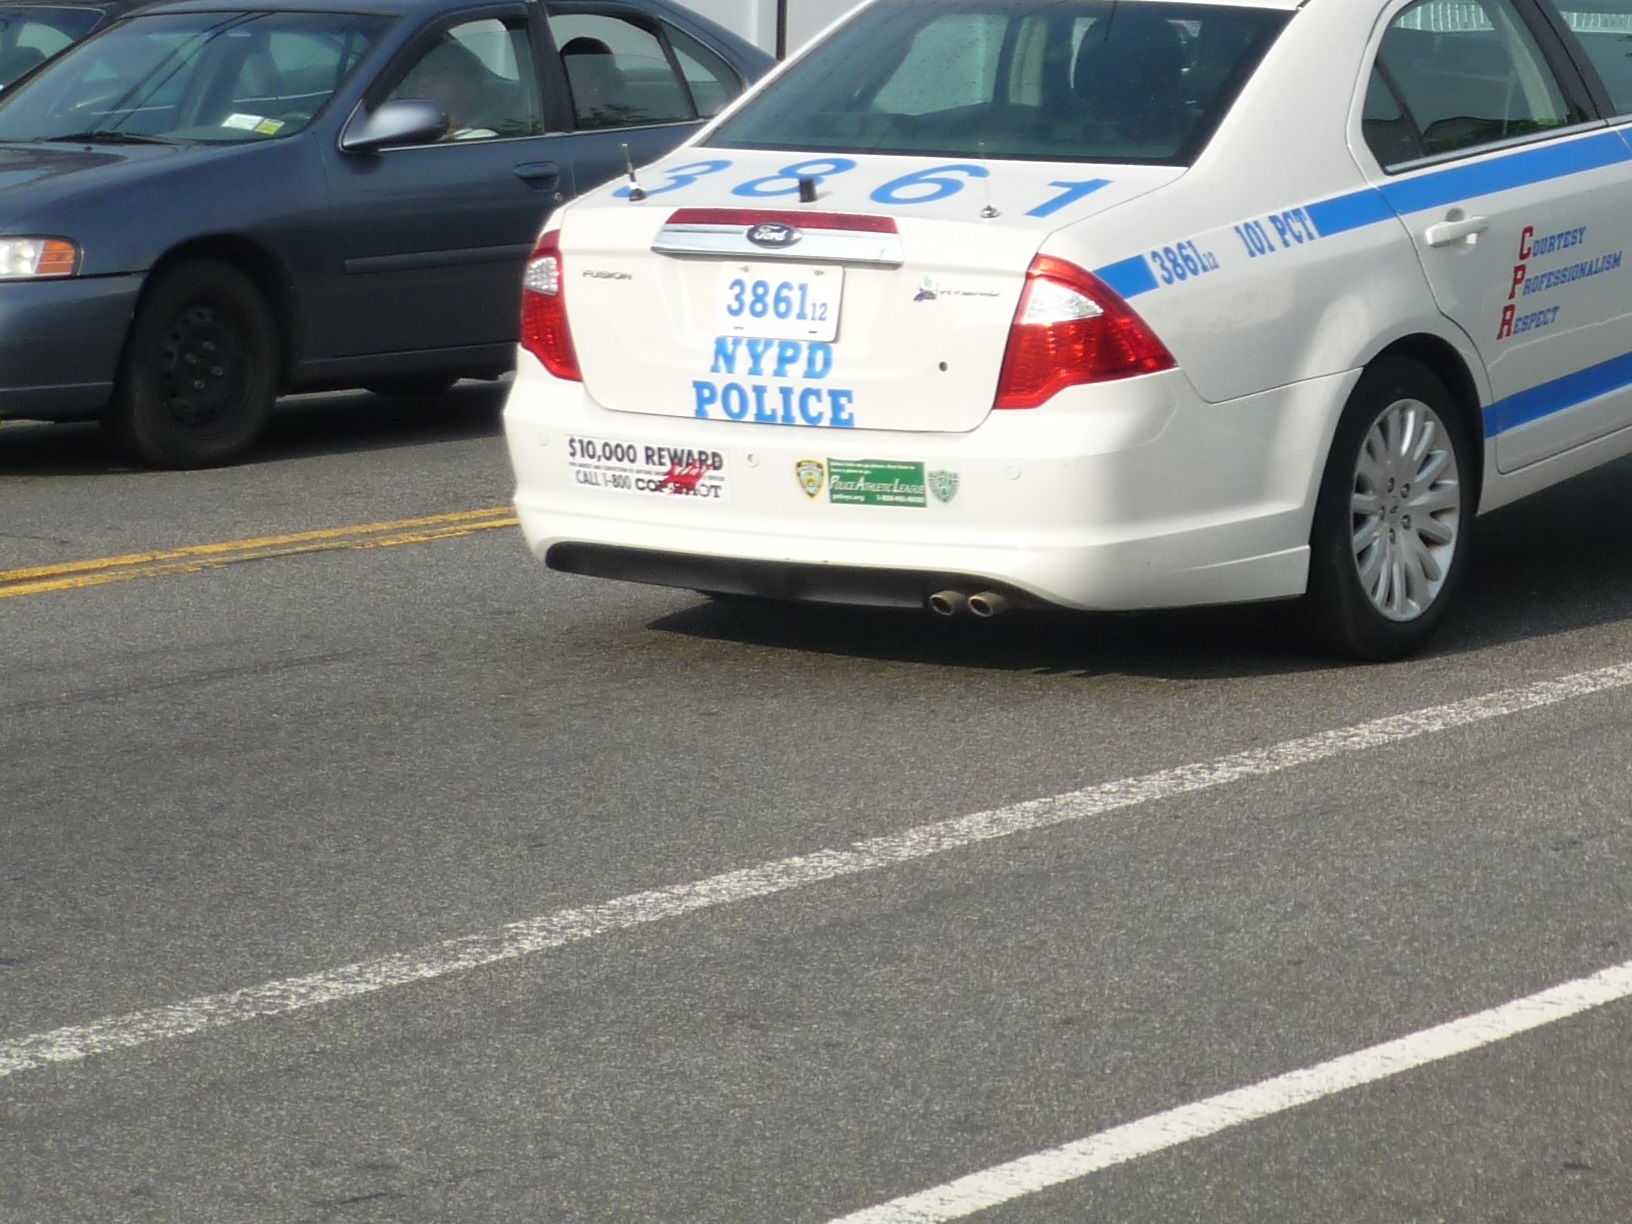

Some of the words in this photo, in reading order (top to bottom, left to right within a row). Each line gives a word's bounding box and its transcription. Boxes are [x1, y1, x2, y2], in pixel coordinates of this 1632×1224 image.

[611, 158, 1113, 218] 3861
[753, 225, 788, 241] Ford
[1234, 220, 1276, 258] 101
[1268, 207, 1316, 248] PCT
[1519, 225, 1586, 261] COURTESY
[1508, 250, 1623, 300] PROFESSIONALISM
[1496, 304, 1560, 340] RESPECT
[710, 335, 833, 380] NYPD
[692, 380, 855, 426] POLICE
[568, 436, 637, 464] $10,000
[644, 445, 724, 471] REWARD
[576, 469, 600, 487] CALL
[603, 473, 632, 490] 1-800
